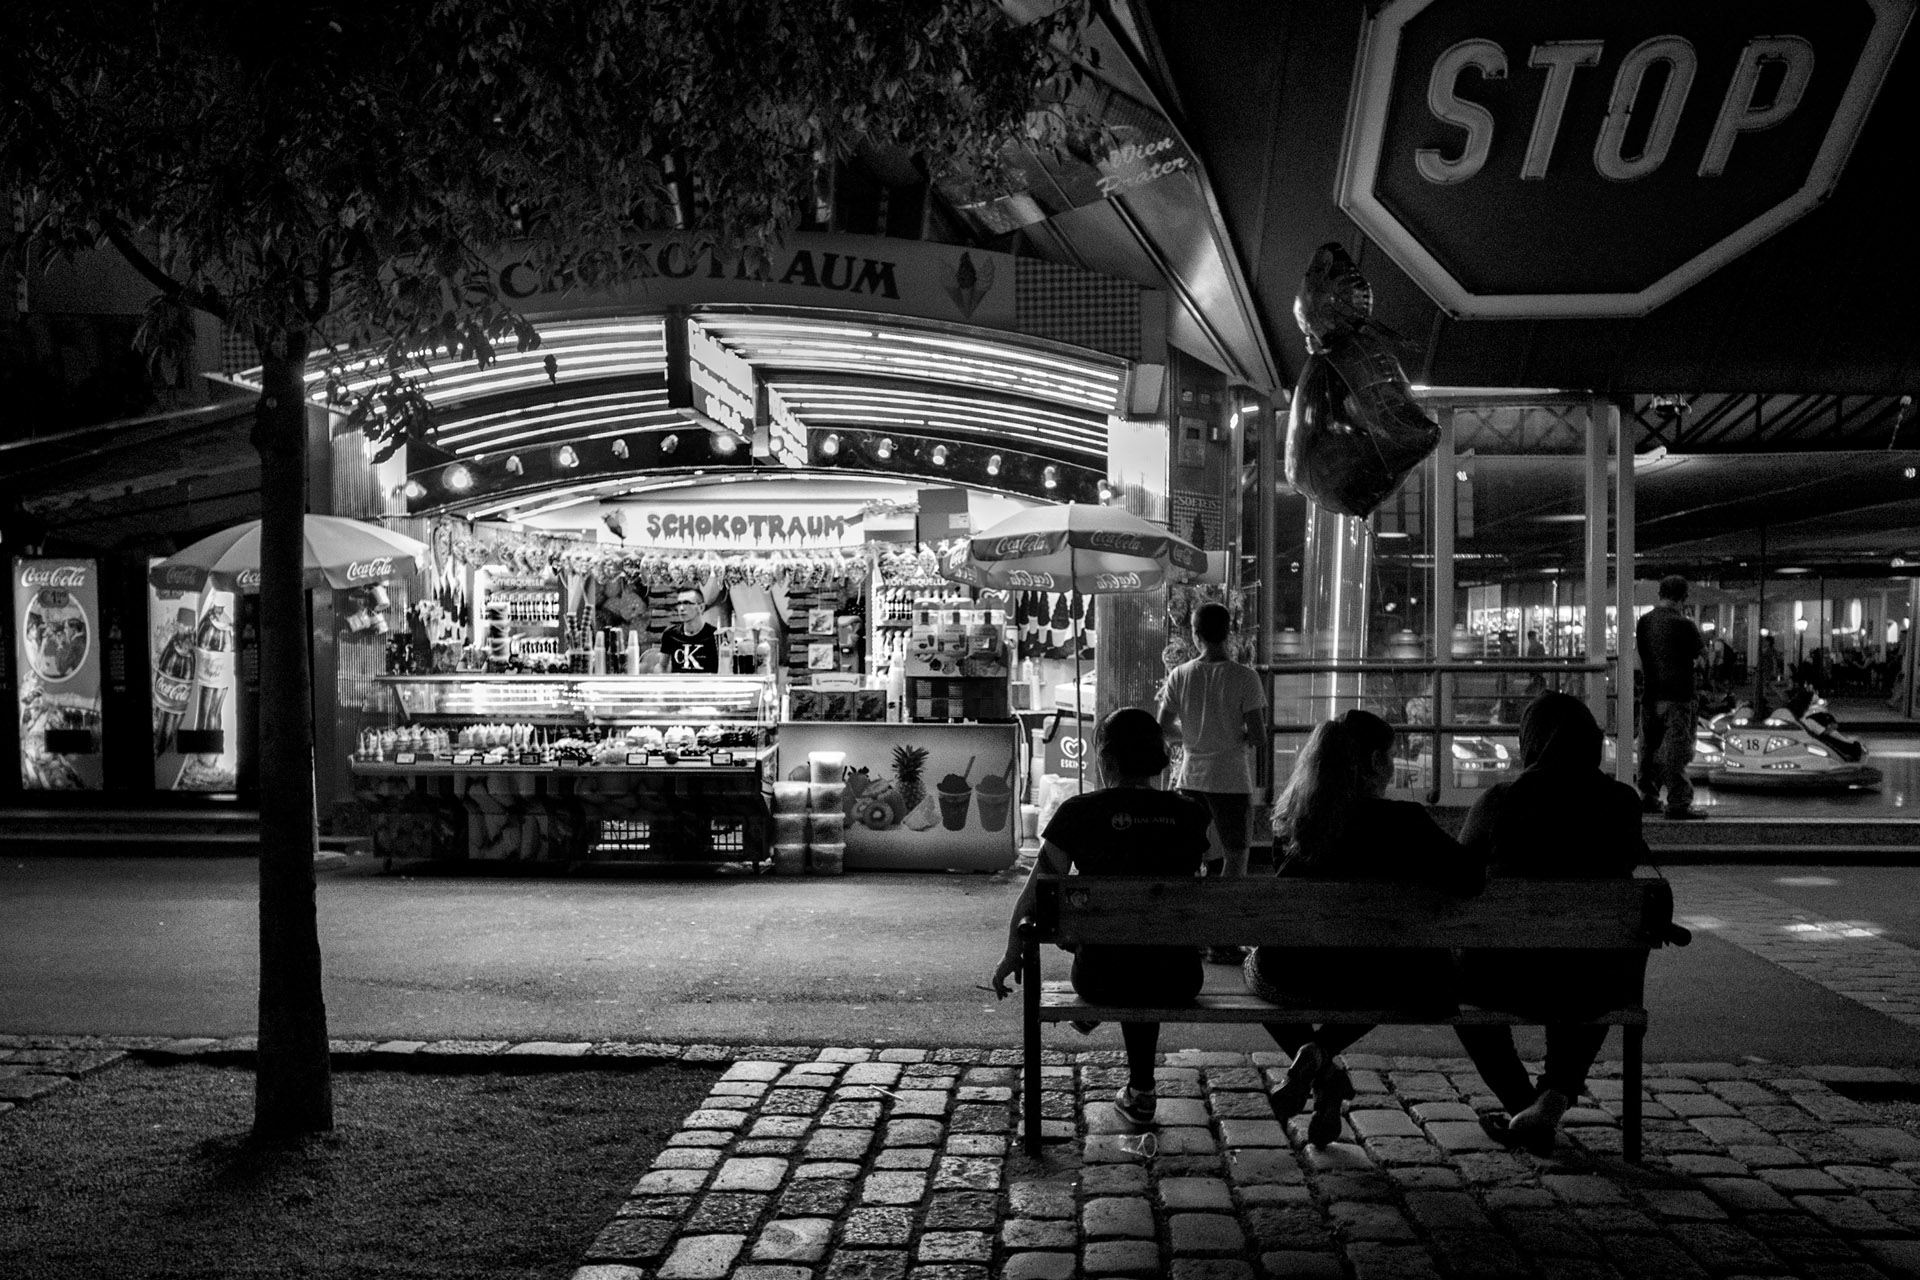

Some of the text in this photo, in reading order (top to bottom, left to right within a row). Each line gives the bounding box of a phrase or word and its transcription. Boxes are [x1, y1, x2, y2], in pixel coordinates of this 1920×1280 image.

[1415, 33, 1816, 184] STOP
[1108, 137, 1175, 168] Wien
[1095, 156, 1189, 198] Prater
[646, 513, 845, 547] SCHOKOTRAUM
[1746, 739, 1760, 751] 18
